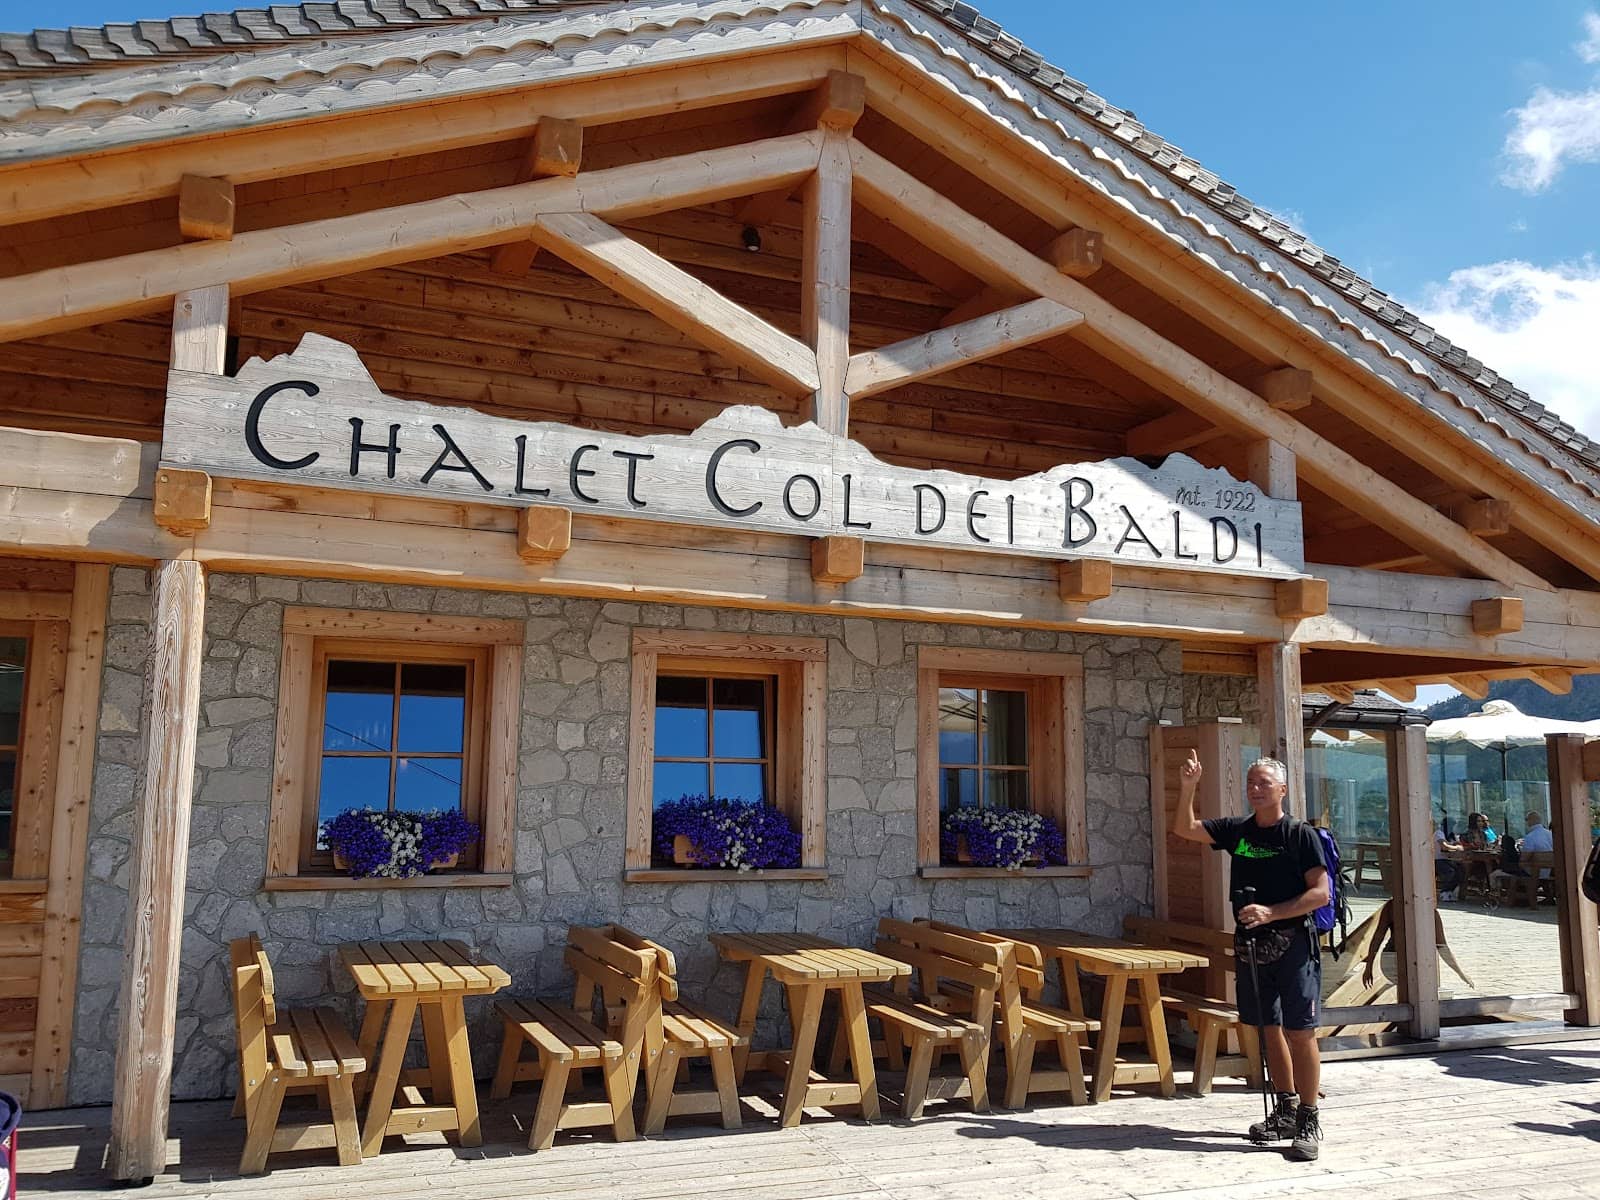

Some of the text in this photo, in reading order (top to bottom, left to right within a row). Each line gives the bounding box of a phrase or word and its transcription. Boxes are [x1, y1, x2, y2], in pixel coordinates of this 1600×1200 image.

[245, 380, 1262, 568] CHALET COL DEI BALDI
[1215, 489, 1256, 512] 1922
